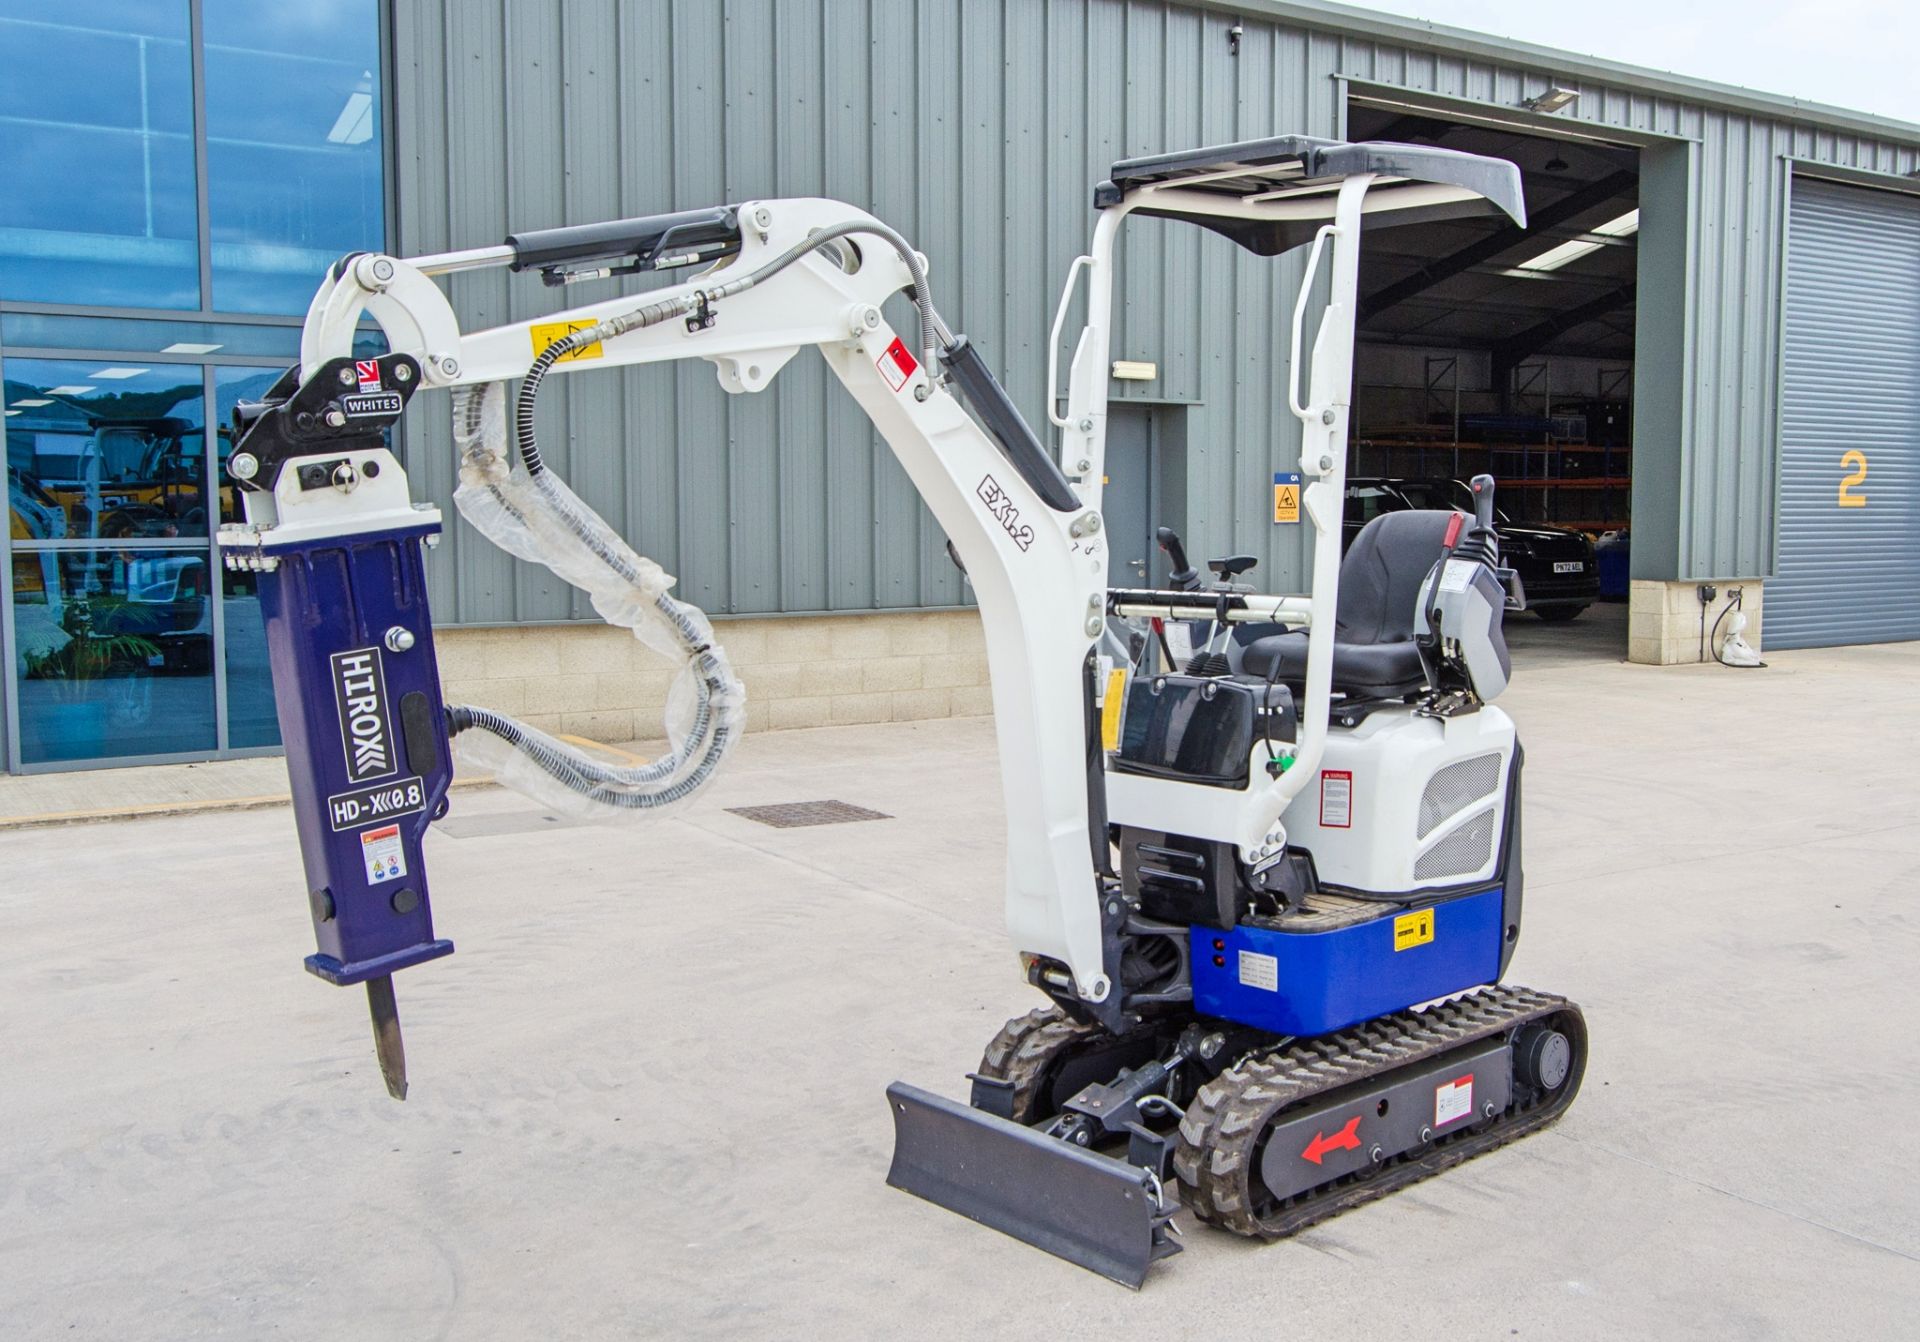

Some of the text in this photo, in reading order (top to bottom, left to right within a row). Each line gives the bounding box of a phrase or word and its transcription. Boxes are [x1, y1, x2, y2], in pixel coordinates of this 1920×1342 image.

[348, 398, 398, 411] WHITES
[1838, 449, 1868, 507] 2
[976, 474, 1035, 553] EX1.2
[341, 653, 384, 754] HIROX
